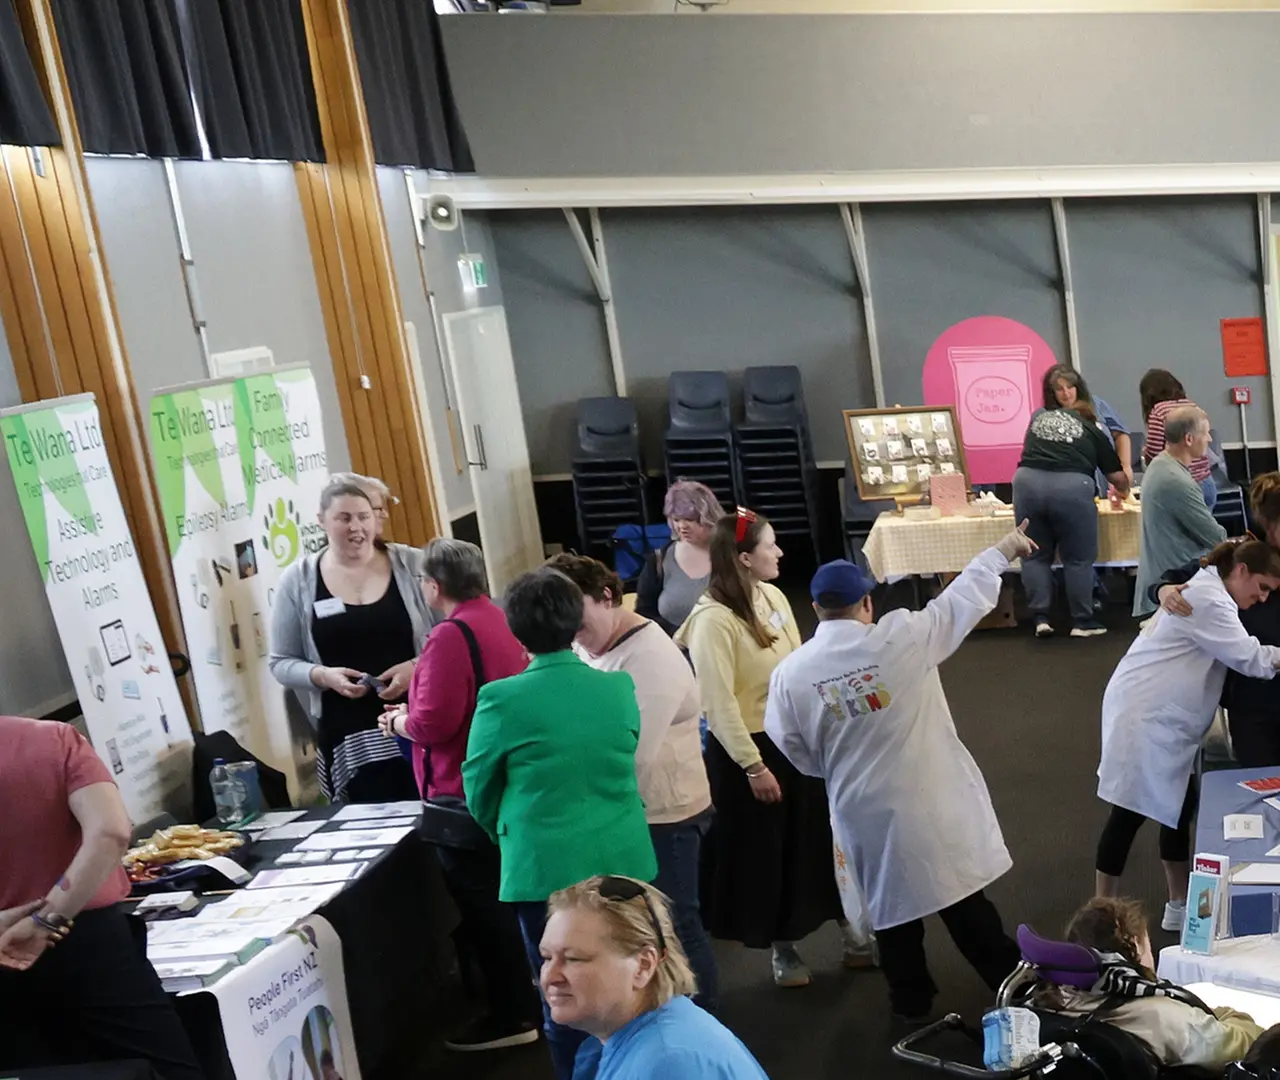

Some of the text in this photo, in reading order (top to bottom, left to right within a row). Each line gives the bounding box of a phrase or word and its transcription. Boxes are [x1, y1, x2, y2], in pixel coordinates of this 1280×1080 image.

[975, 387, 1014, 399] Paper
[7, 418, 101, 467] Te Wana Ltd
[152, 411, 177, 442] Te
[45, 539, 134, 585] Technology and
[81, 581, 120, 611] Alarms
[248, 951, 318, 1016] People First NZ
